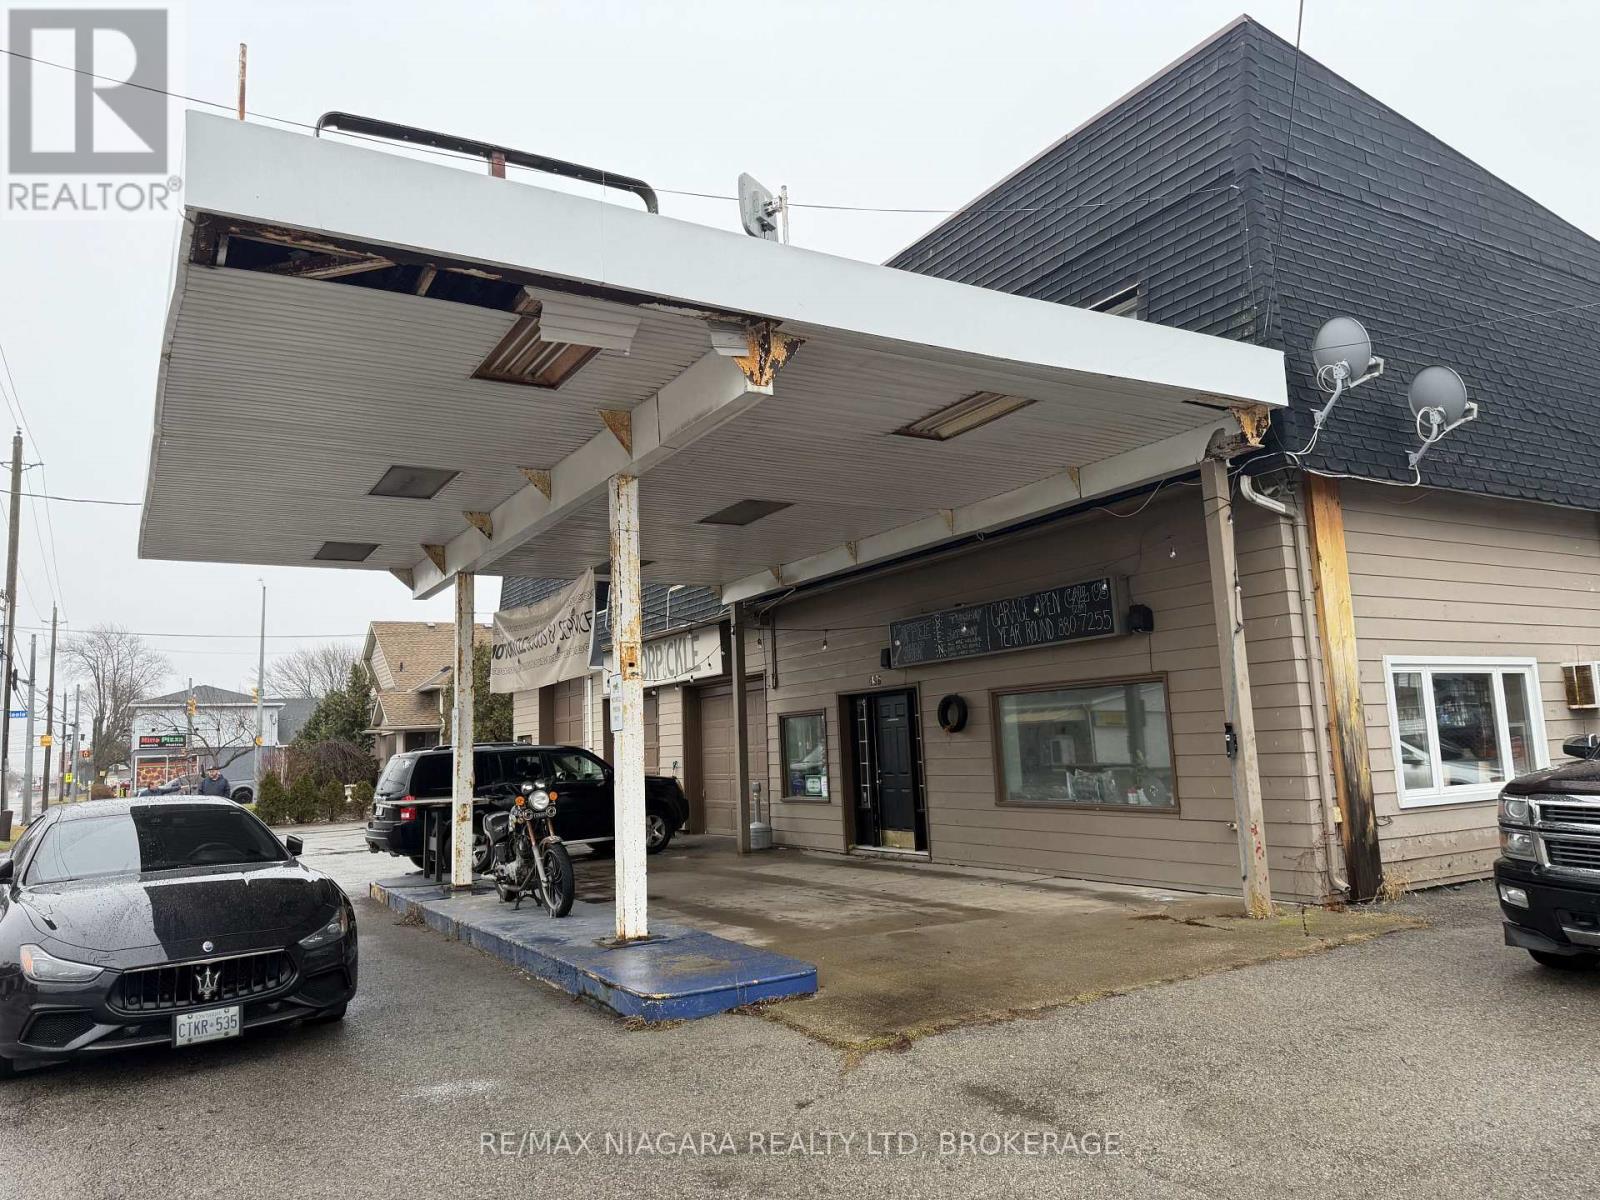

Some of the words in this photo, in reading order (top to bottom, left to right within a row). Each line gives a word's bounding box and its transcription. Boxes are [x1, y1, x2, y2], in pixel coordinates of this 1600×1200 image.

[990, 598, 1031, 628] GARAGE
[997, 623, 1023, 648] YEAR
[1025, 617, 1055, 644] ROUND
[178, 1019, 208, 1038] CTKR
[216, 1014, 238, 1032] 535
